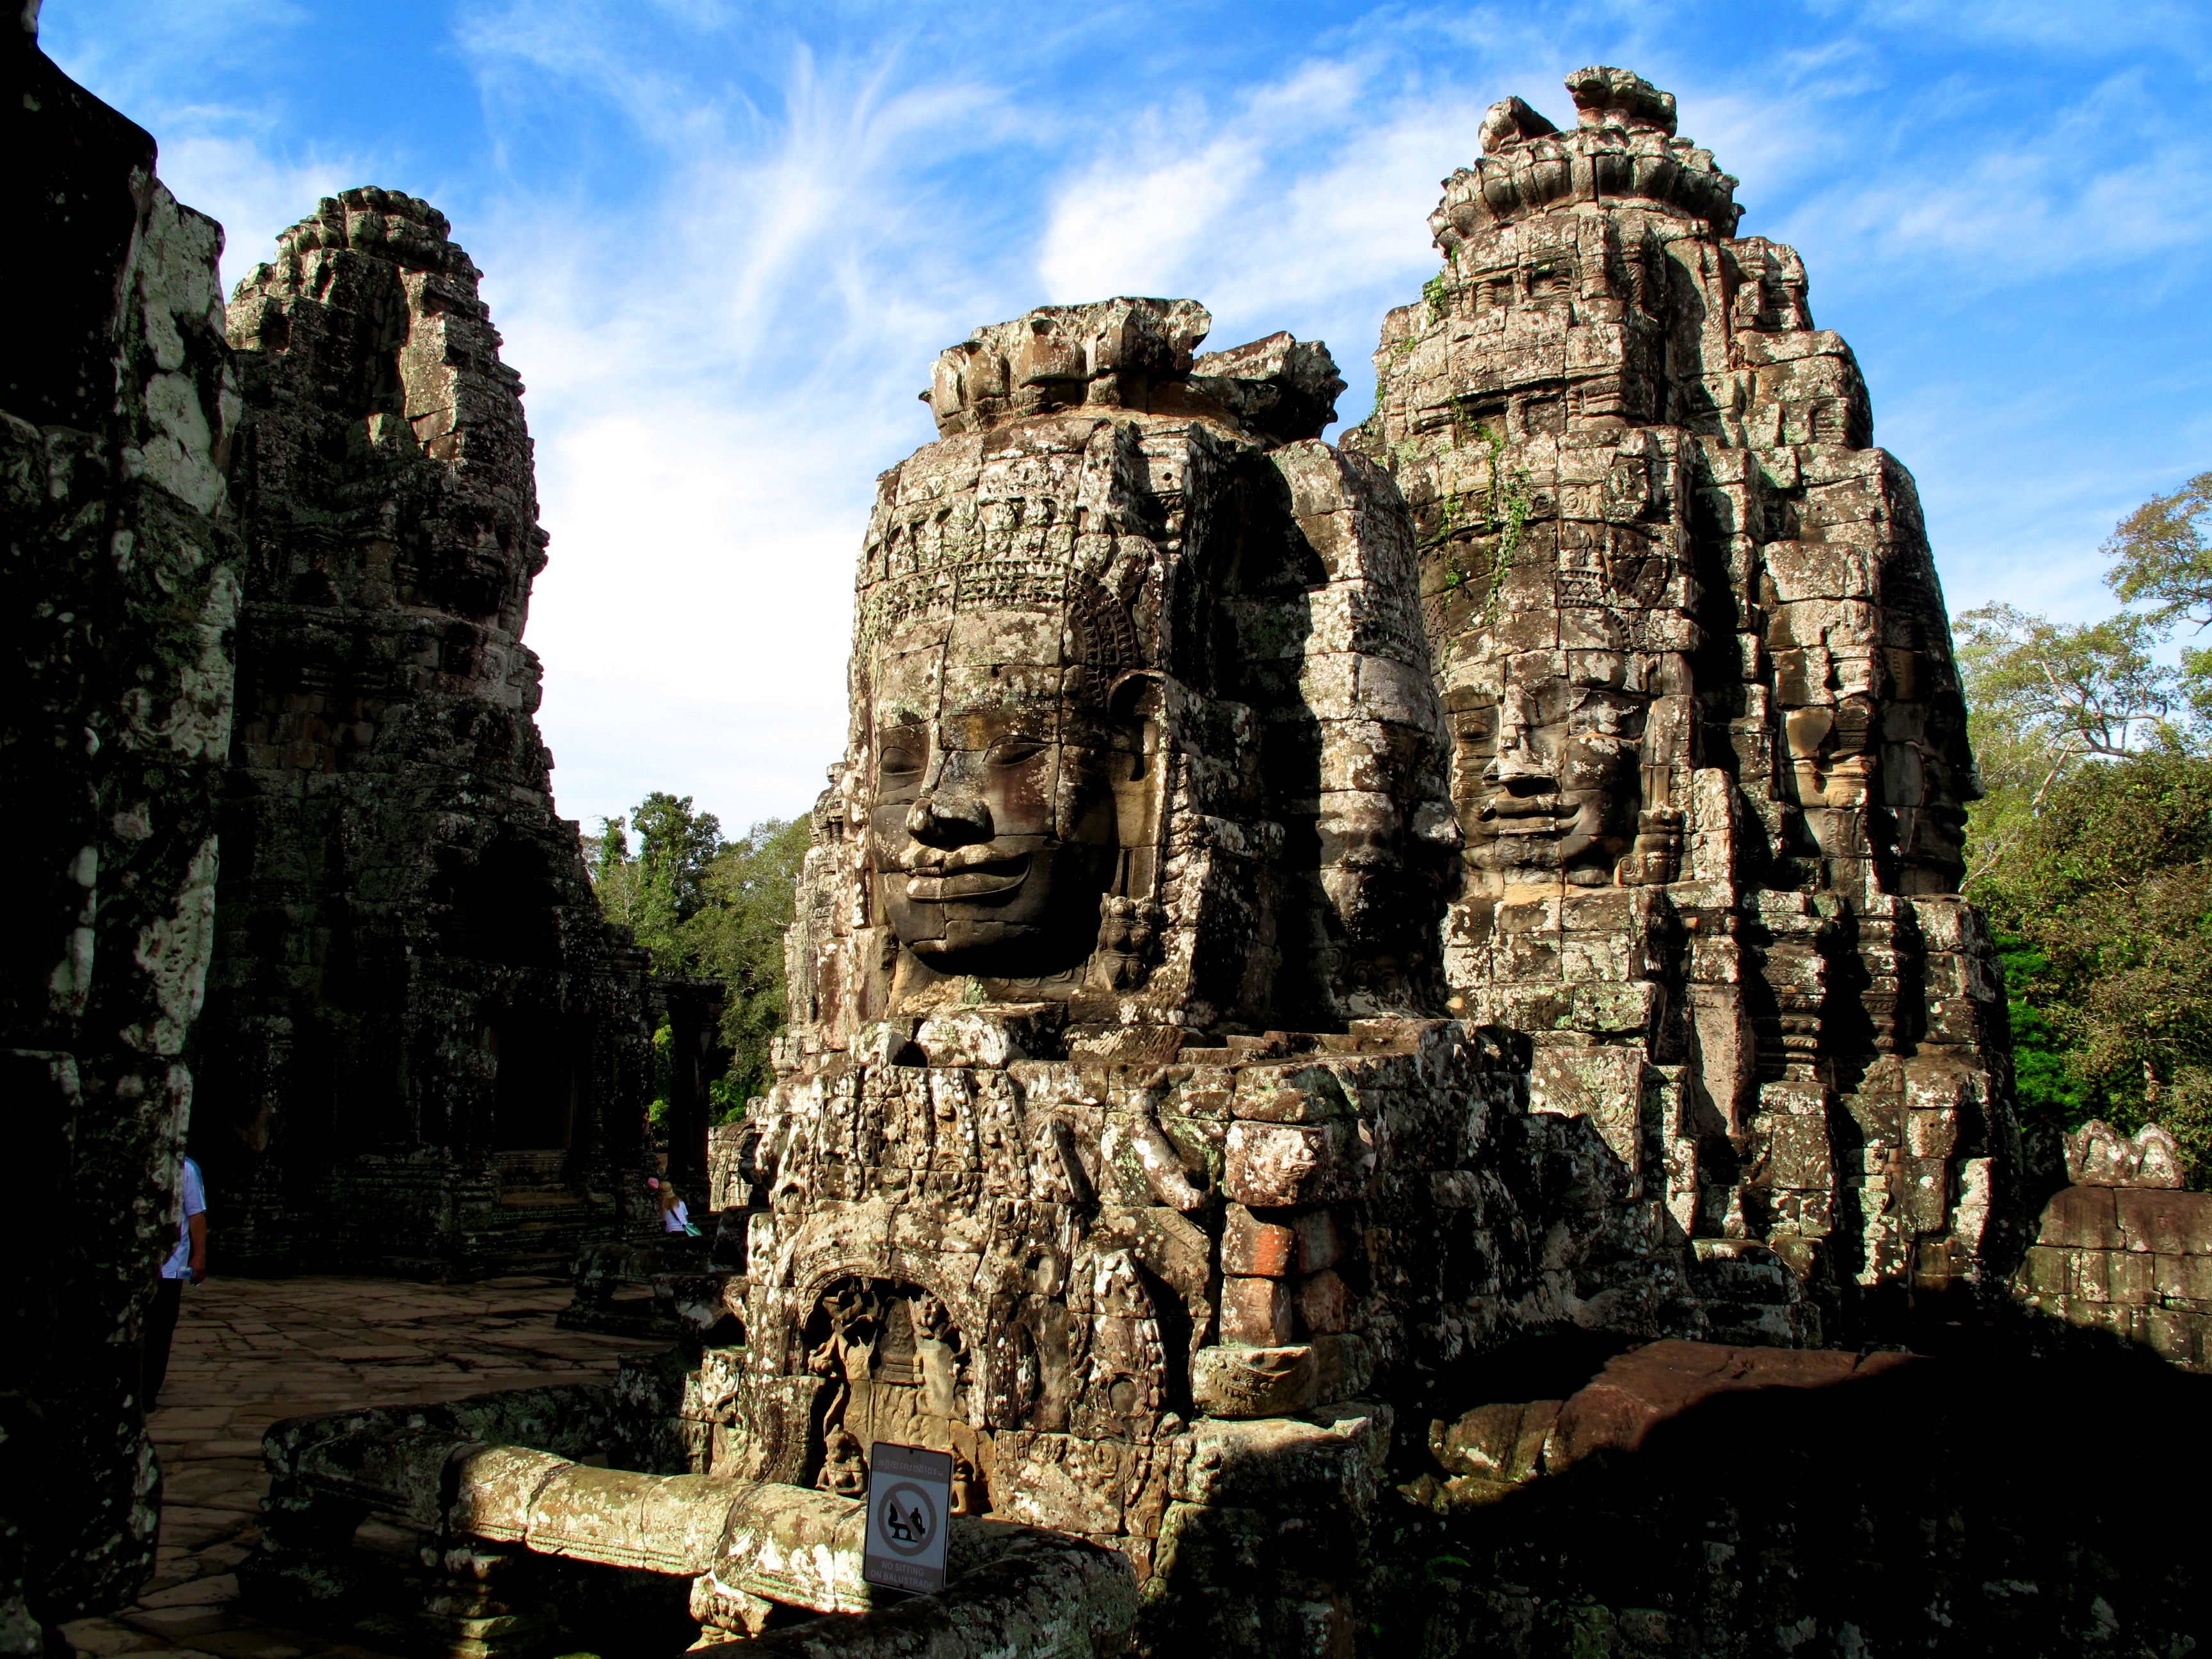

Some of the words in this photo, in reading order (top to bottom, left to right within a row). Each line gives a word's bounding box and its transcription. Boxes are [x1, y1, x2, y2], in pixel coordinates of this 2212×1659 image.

[882, 1561, 893, 1569] NO
[895, 1563, 924, 1576] SITTING
[870, 1569, 881, 1578] ON
[884, 1572, 934, 1589] BALUSTRADE
